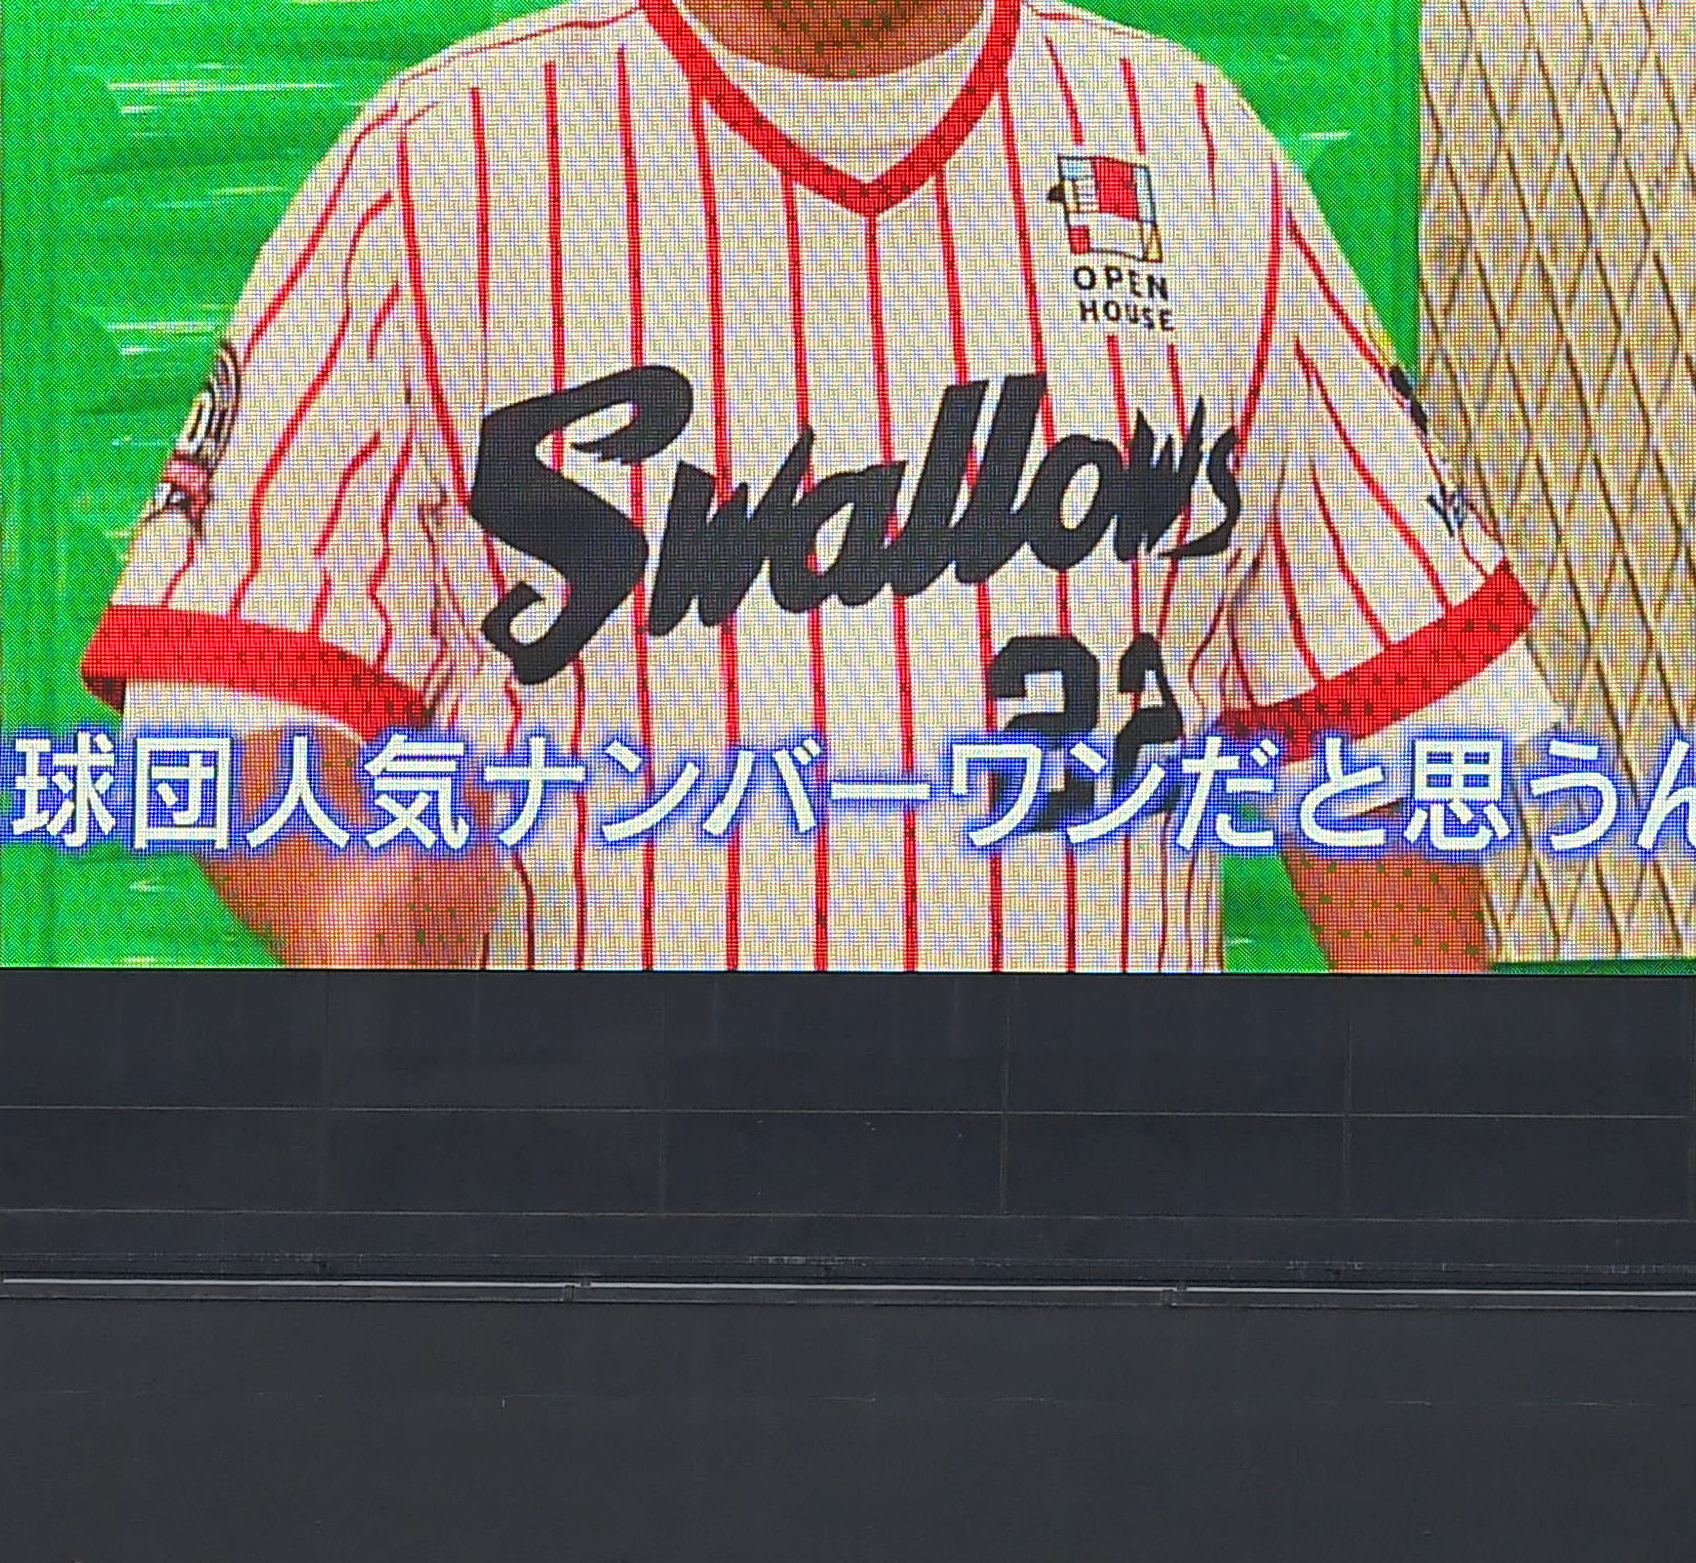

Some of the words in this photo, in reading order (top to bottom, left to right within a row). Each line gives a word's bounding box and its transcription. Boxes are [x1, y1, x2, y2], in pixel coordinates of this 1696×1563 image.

[1072, 265, 1170, 302] OPEN
[1078, 299, 1176, 332] HOUSE
[468, 364, 1244, 686] Swallows
